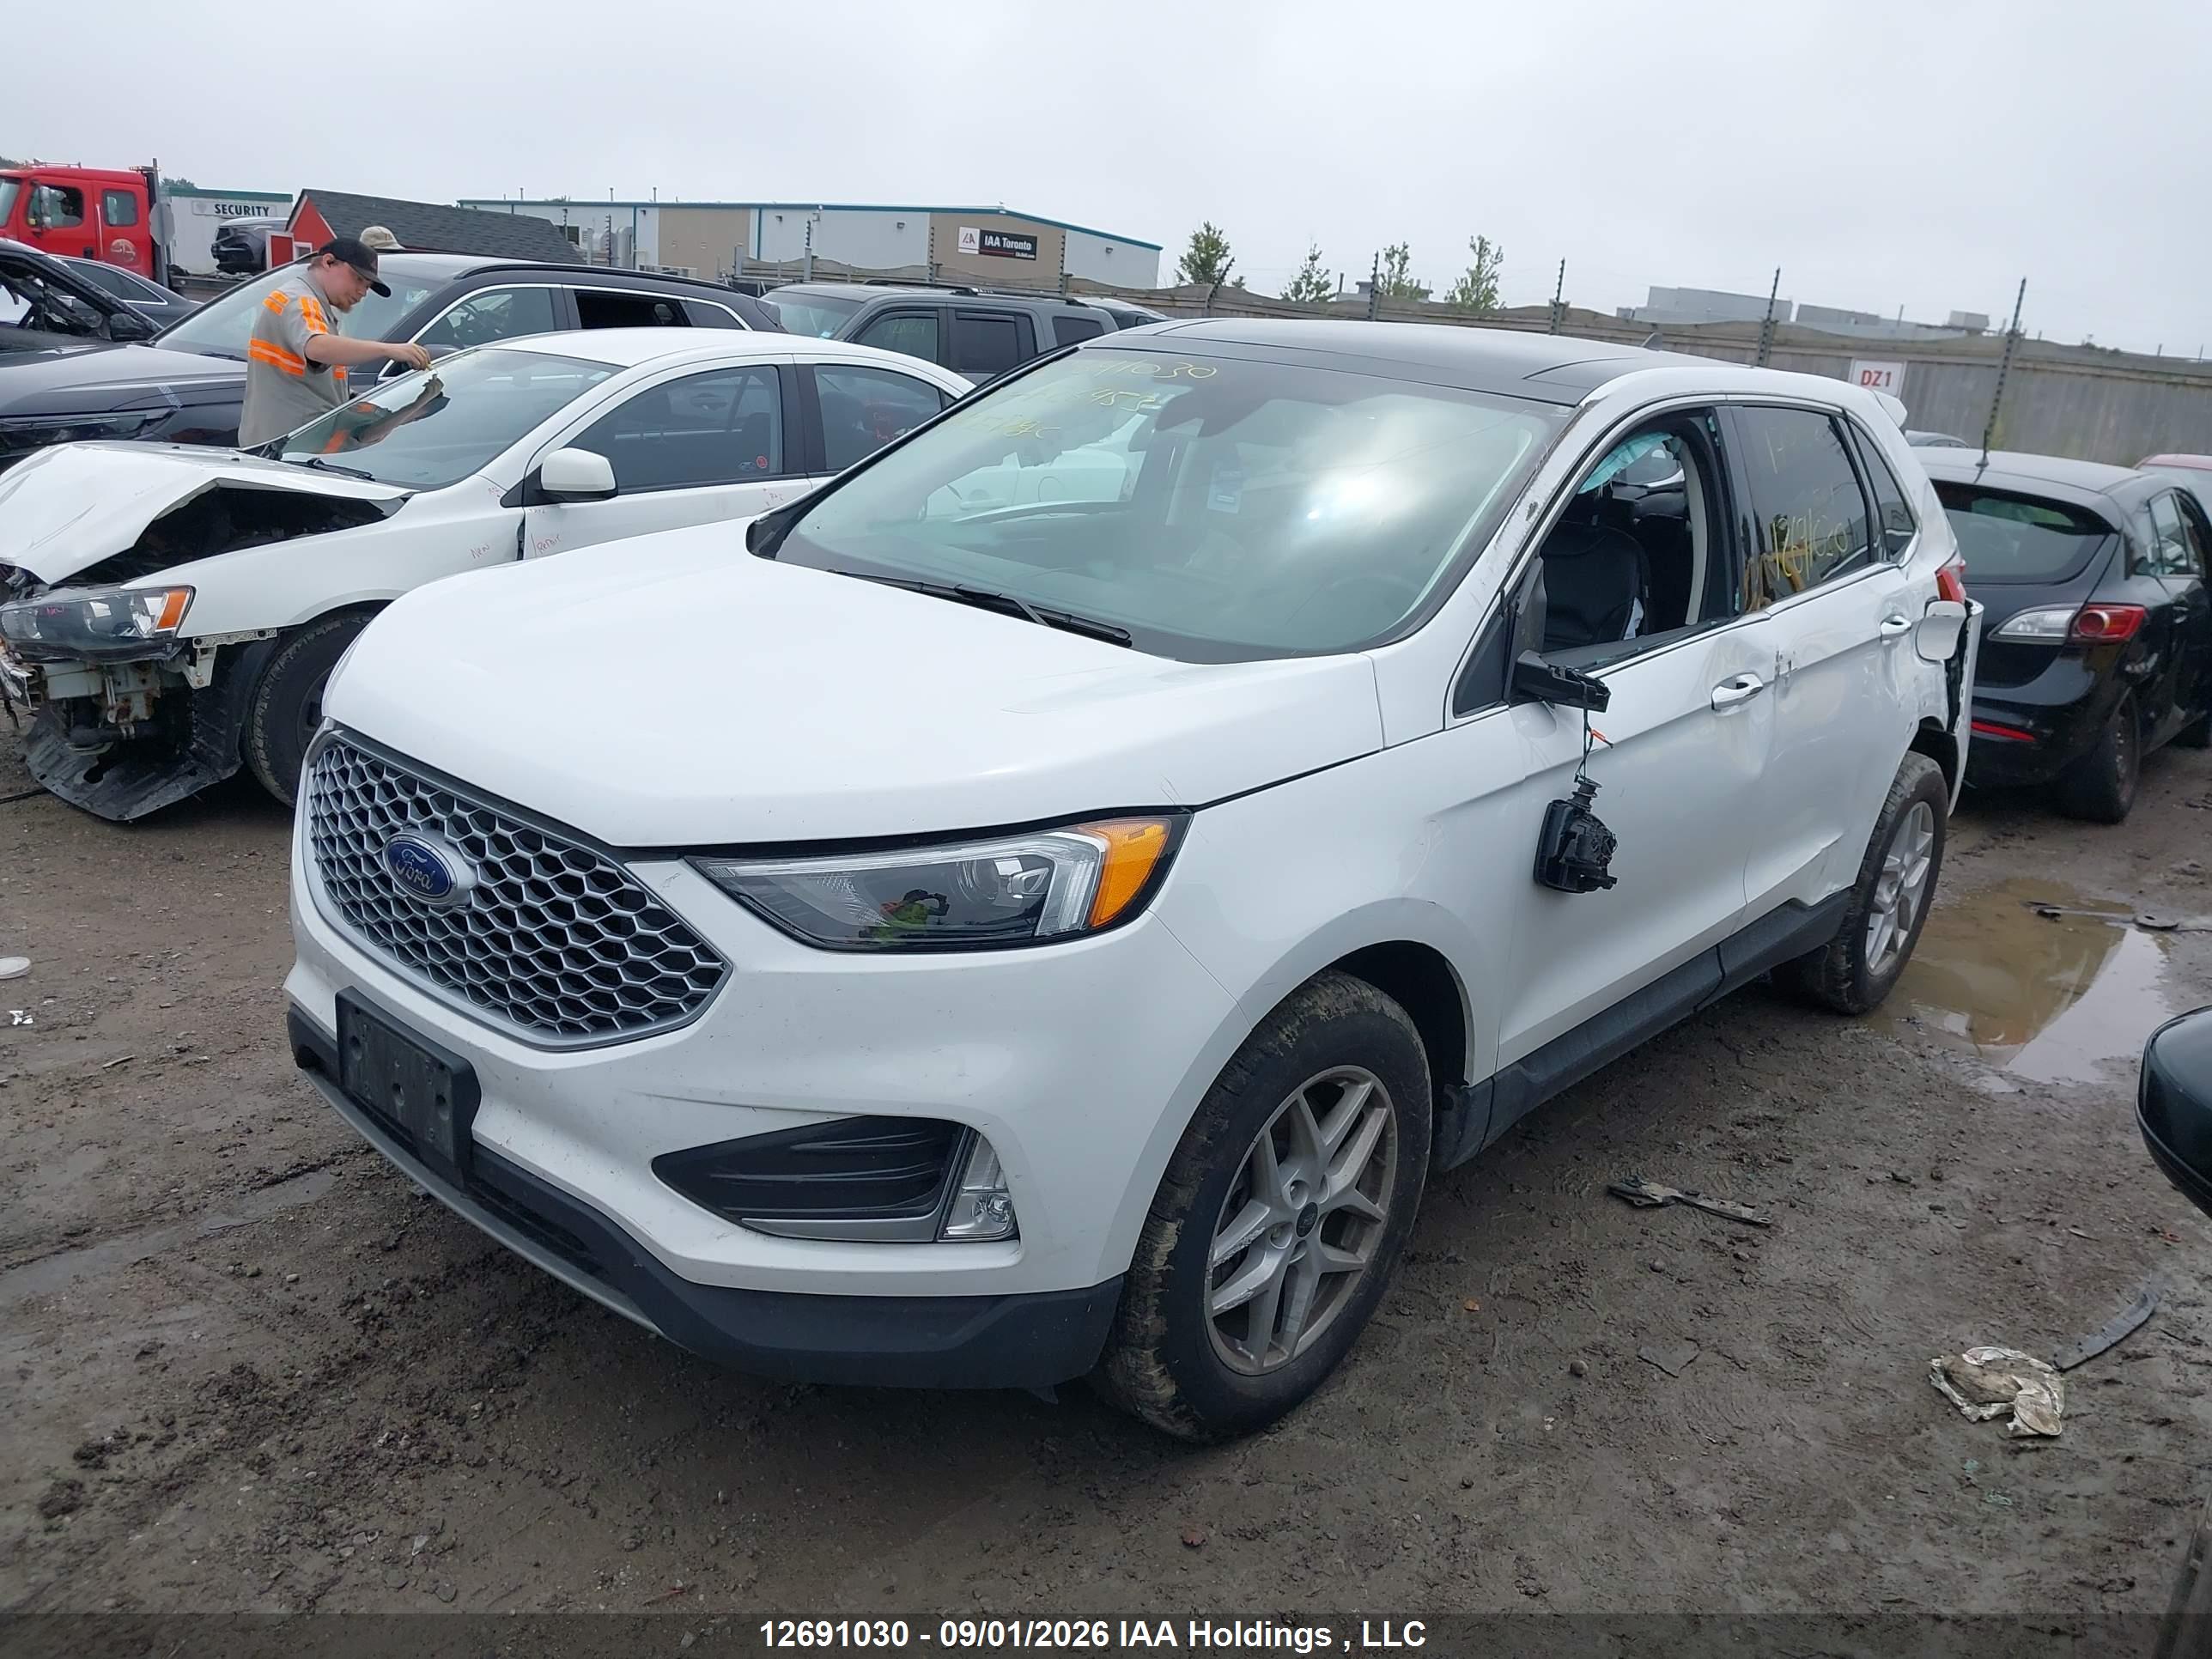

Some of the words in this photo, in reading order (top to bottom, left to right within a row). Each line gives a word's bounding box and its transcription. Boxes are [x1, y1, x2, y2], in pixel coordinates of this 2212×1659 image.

[214, 204, 270, 216] SECURITY
[984, 234, 1000, 247] IAA
[1002, 237, 1032, 251] Toronto
[1860, 369, 1892, 387] DZ1
[395, 848, 435, 890] Ford
